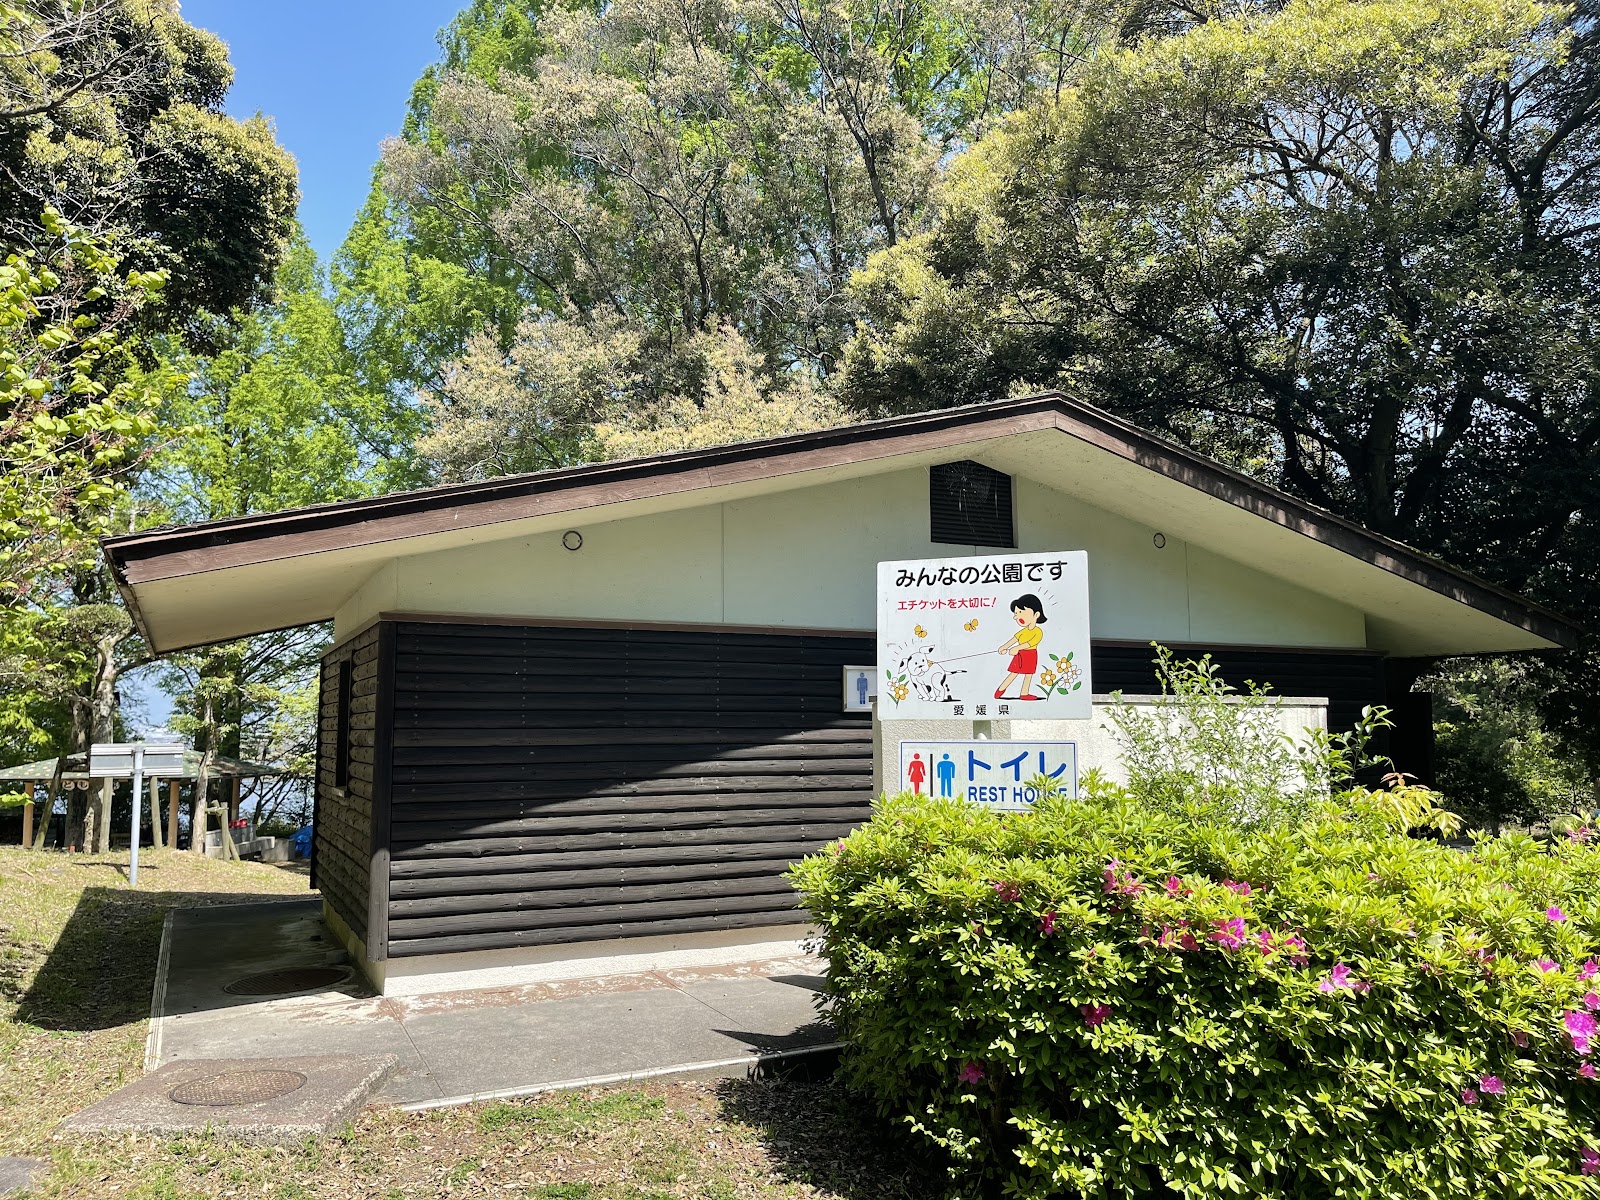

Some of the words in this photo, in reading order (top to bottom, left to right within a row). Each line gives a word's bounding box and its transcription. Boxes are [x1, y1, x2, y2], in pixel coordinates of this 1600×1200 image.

[895, 560, 1068, 588] みんなの公園です
[967, 751, 1067, 782] トイレ
[967, 786, 1008, 803] REST
